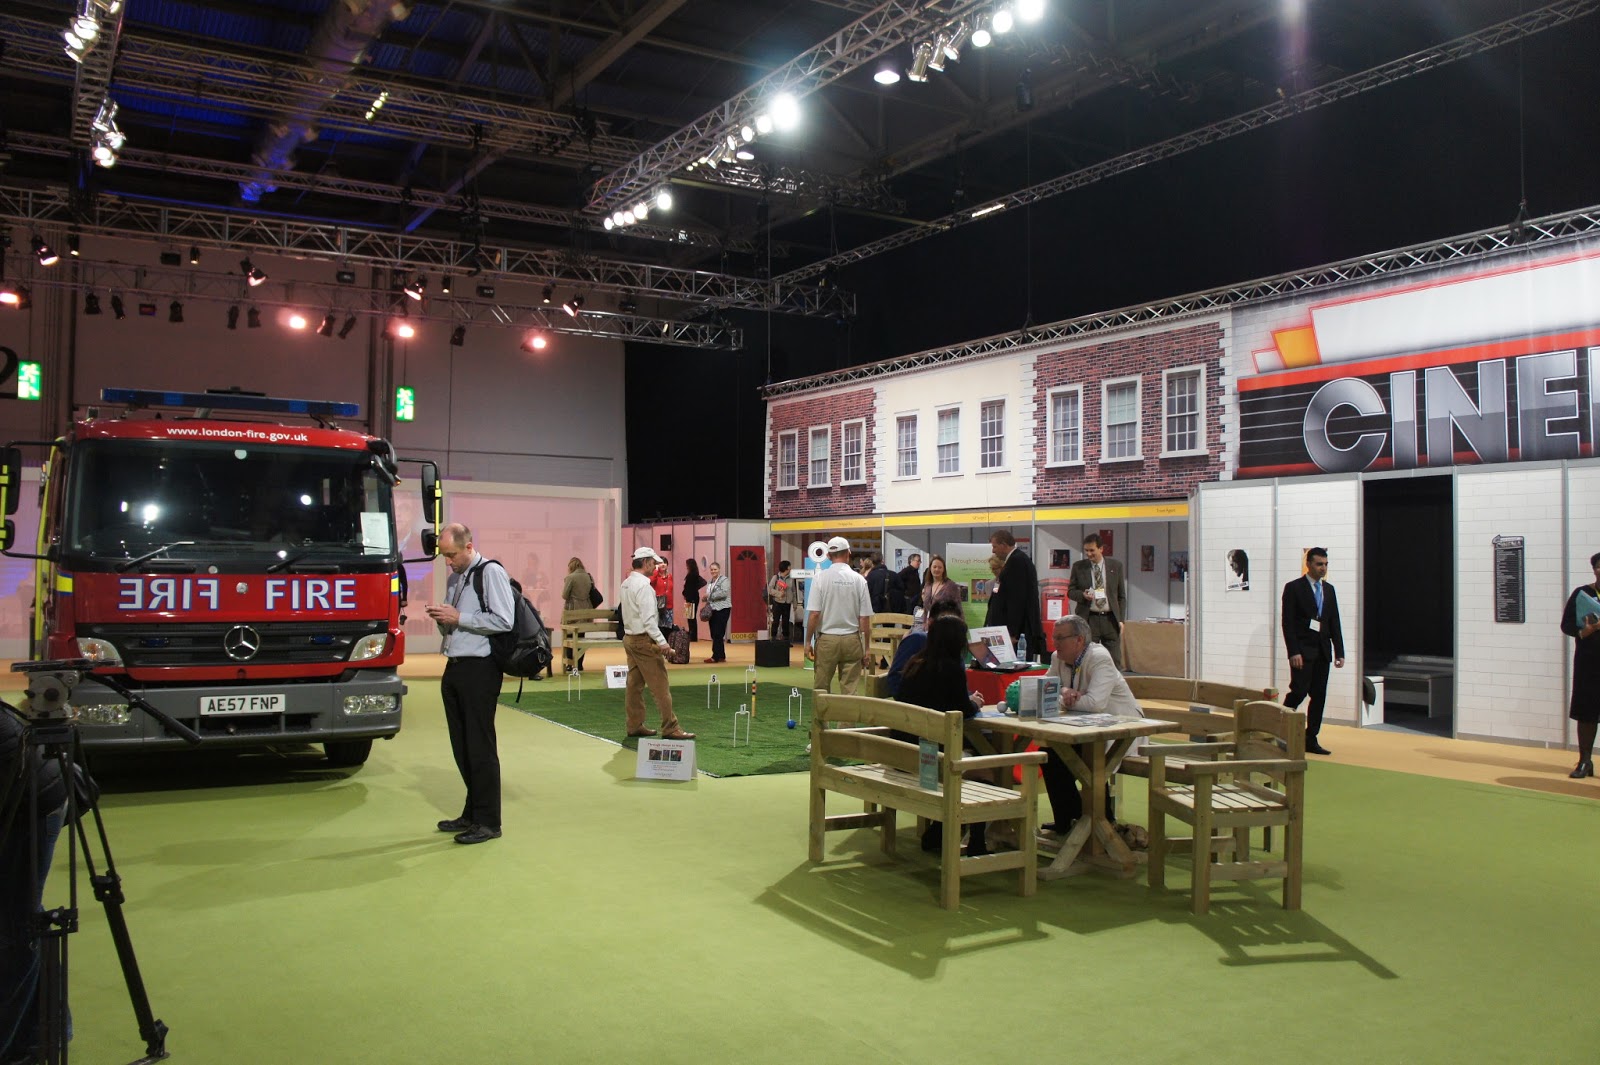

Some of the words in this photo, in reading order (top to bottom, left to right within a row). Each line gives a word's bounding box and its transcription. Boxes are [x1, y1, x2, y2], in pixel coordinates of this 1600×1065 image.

[1303, 347, 1600, 473] CINE
[166, 427, 308, 442] www.london-fire.gov.uk
[265, 579, 356, 610] FIRE
[792, 688, 798, 697] 5
[207, 697, 246, 712] AE57
[250, 696, 279, 711] FNP
